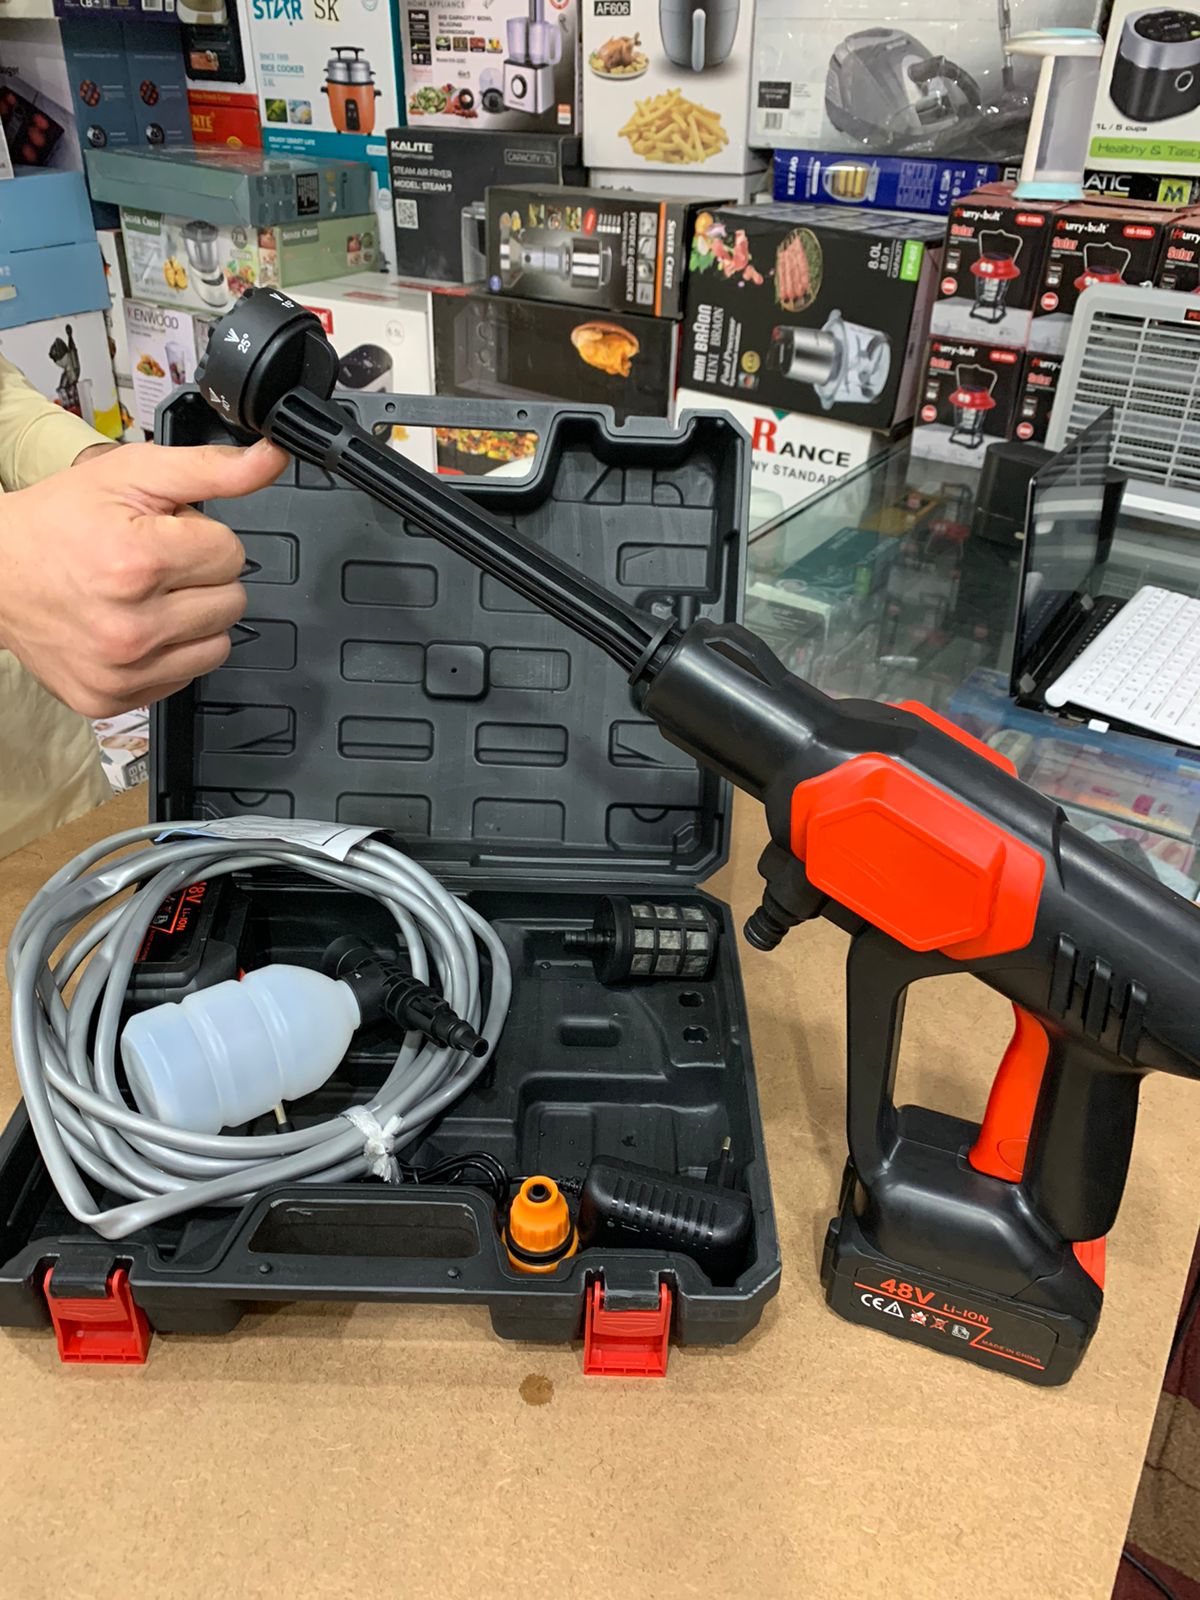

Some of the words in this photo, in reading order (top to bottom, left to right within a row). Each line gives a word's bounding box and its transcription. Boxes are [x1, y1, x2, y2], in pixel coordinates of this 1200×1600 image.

[314, 0, 340, 22] SK
[596, 3, 630, 15] AF606
[1097, 143, 1148, 156] Healthy
[1150, 145, 1161, 155] &
[1162, 185, 1184, 202] M
[868, 242, 882, 270] 8.0L
[237, 332, 251, 354] 25°
[186, 881, 207, 904] 8V
[880, 1278, 935, 1305] 48V
[943, 1303, 990, 1325] Li-ION
[982, 1339, 1005, 1352] MADE
[1005, 1346, 1014, 1354] IN
[1014, 1348, 1042, 1364] CHINA
